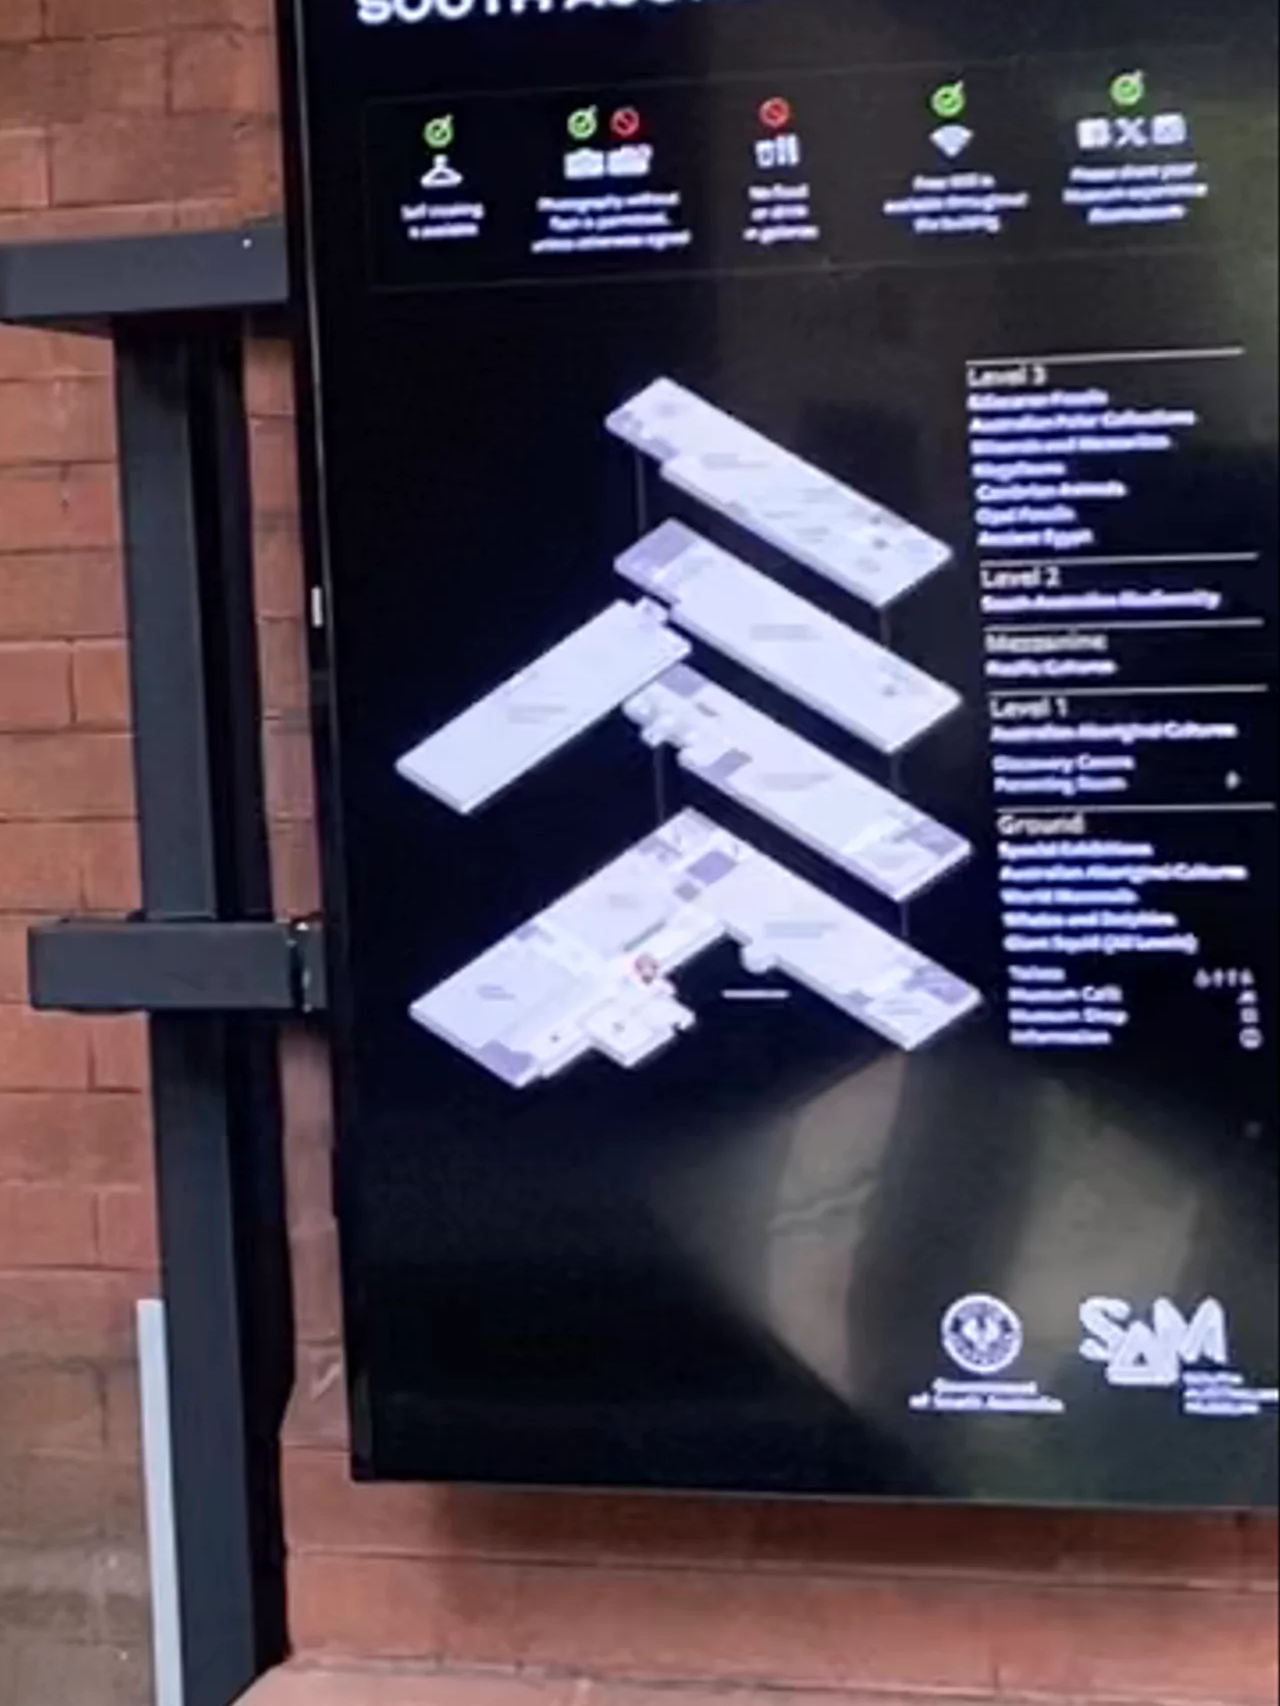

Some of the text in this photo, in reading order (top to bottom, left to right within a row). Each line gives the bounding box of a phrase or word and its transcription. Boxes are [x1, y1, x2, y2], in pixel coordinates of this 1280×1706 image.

[980, 566, 1061, 589] Level 2
[990, 697, 1068, 719] Level 1
[997, 813, 1086, 836] Ground
